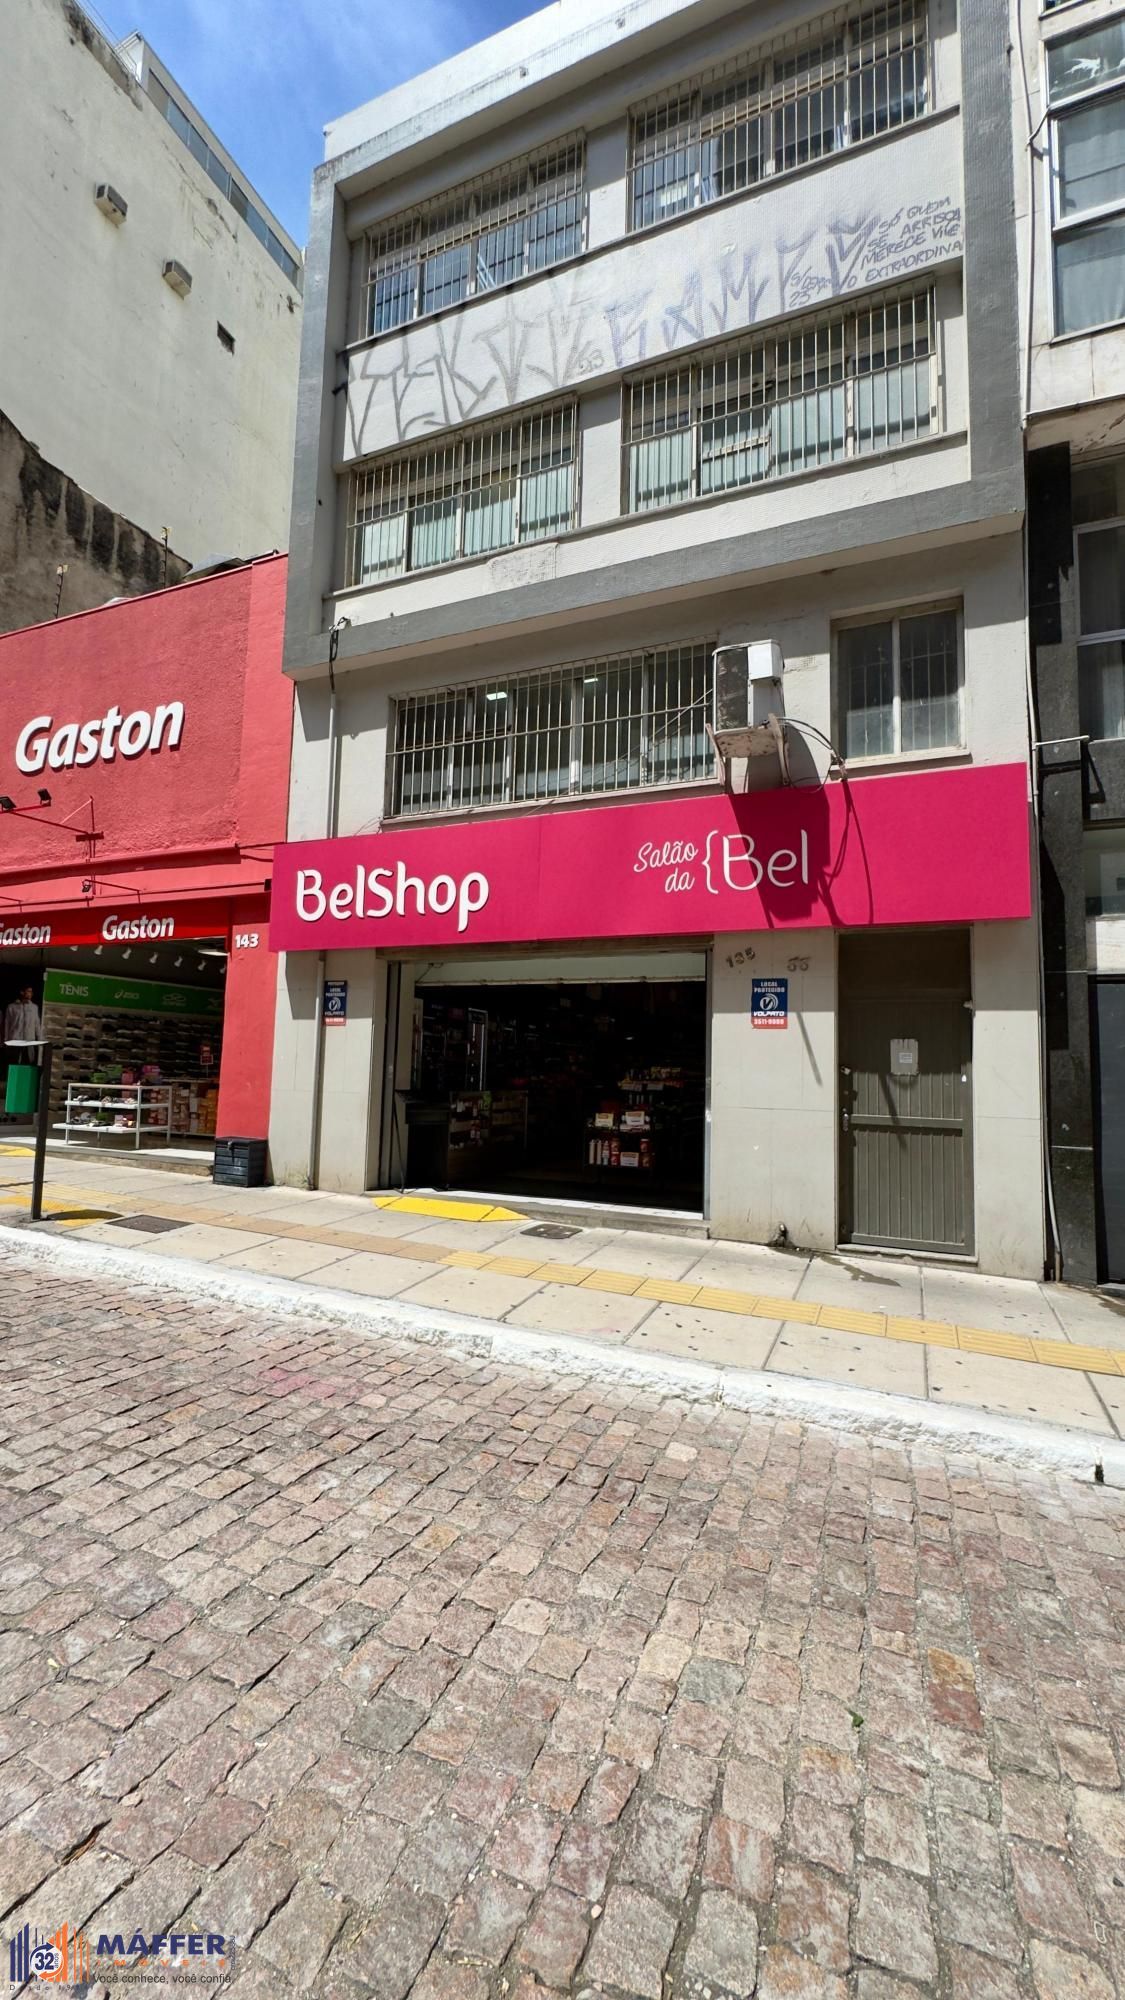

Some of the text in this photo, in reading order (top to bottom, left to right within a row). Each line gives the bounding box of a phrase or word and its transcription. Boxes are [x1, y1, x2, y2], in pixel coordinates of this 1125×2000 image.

[860, 231, 926, 271] MERECE
[15, 701, 186, 774] Gaston
[633, 840, 699, 873] Salão
[664, 867, 696, 894] da
[296, 861, 490, 933] BelShop
[102, 914, 175, 941] Gaston
[234, 933, 259, 948] 143
[59, 982, 89, 997] TÊNIS
